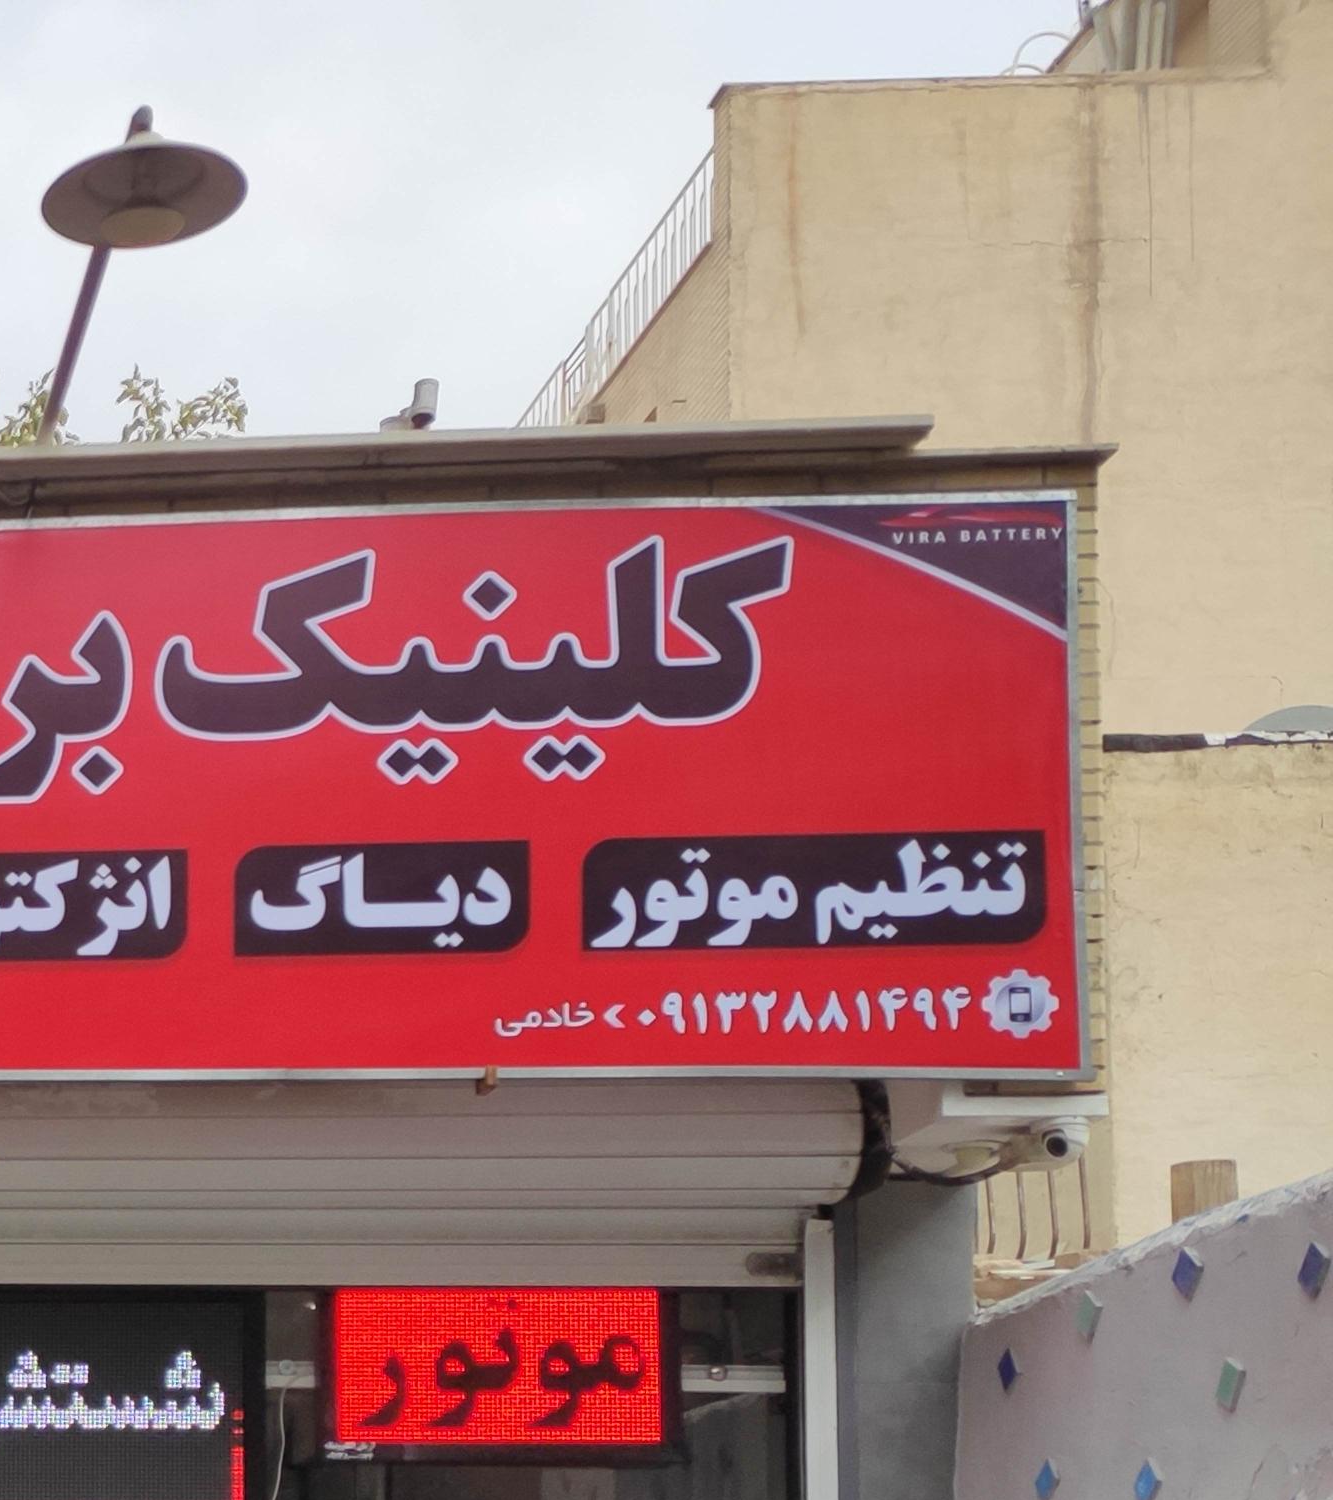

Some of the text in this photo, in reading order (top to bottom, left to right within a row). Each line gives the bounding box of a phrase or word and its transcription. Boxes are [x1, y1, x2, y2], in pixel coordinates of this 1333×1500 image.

[892, 527, 1063, 545] VIRA BATTERY
[153, 534, 795, 785] کلینیک
[249, 852, 512, 948] دیاگ
[589, 840, 1028, 948] تنظیم موتور
[494, 1002, 595, 1038] خادمی
